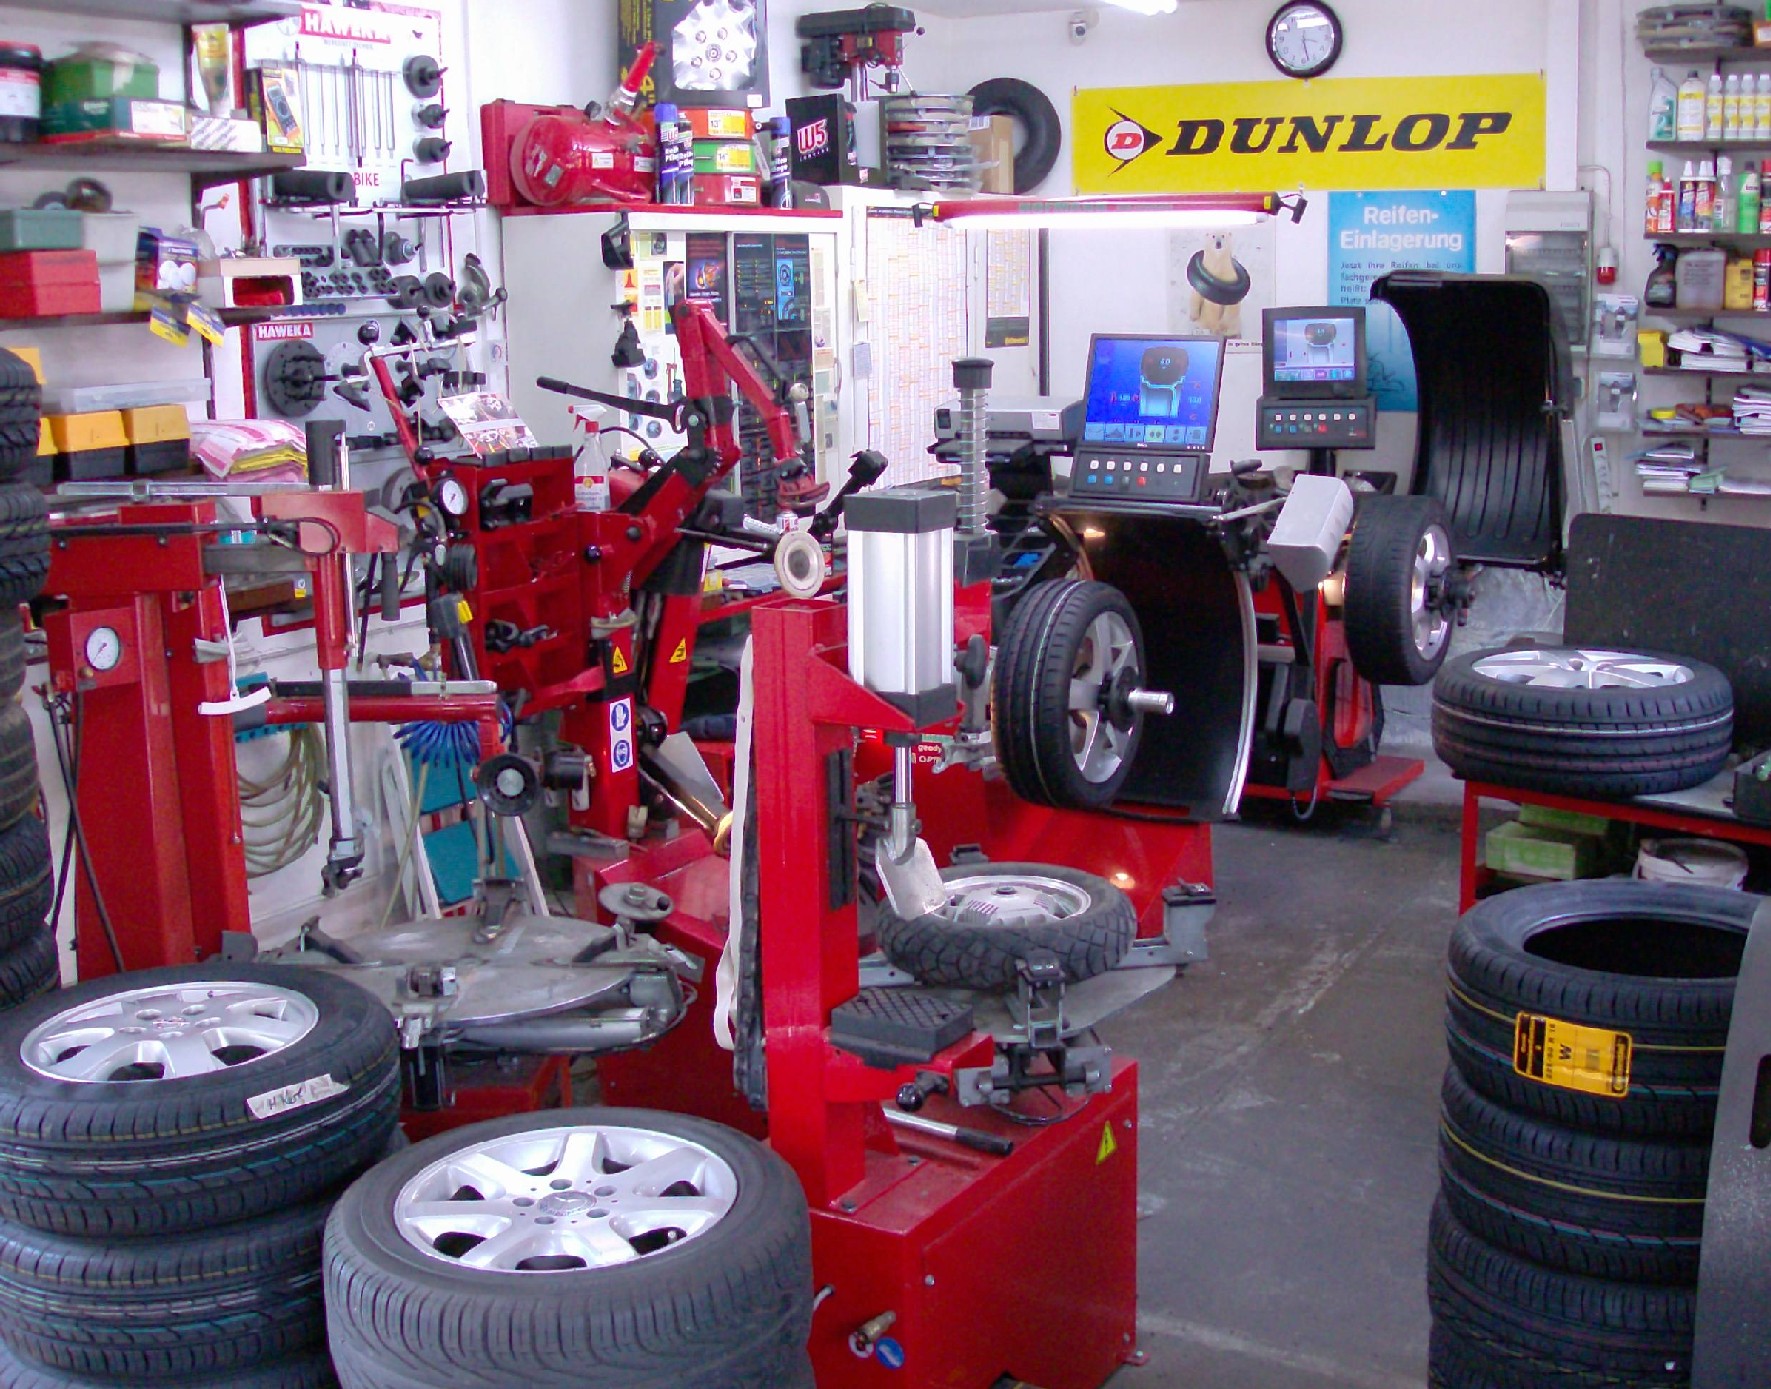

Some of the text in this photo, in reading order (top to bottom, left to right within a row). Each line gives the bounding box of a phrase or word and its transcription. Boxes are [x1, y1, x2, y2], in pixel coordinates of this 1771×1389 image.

[1111, 112, 1512, 156] D DUNLOP
[1363, 206, 1439, 225] Reifen-
[1340, 231, 1462, 252] Einlagerung
[258, 323, 312, 339] HAWEKA
